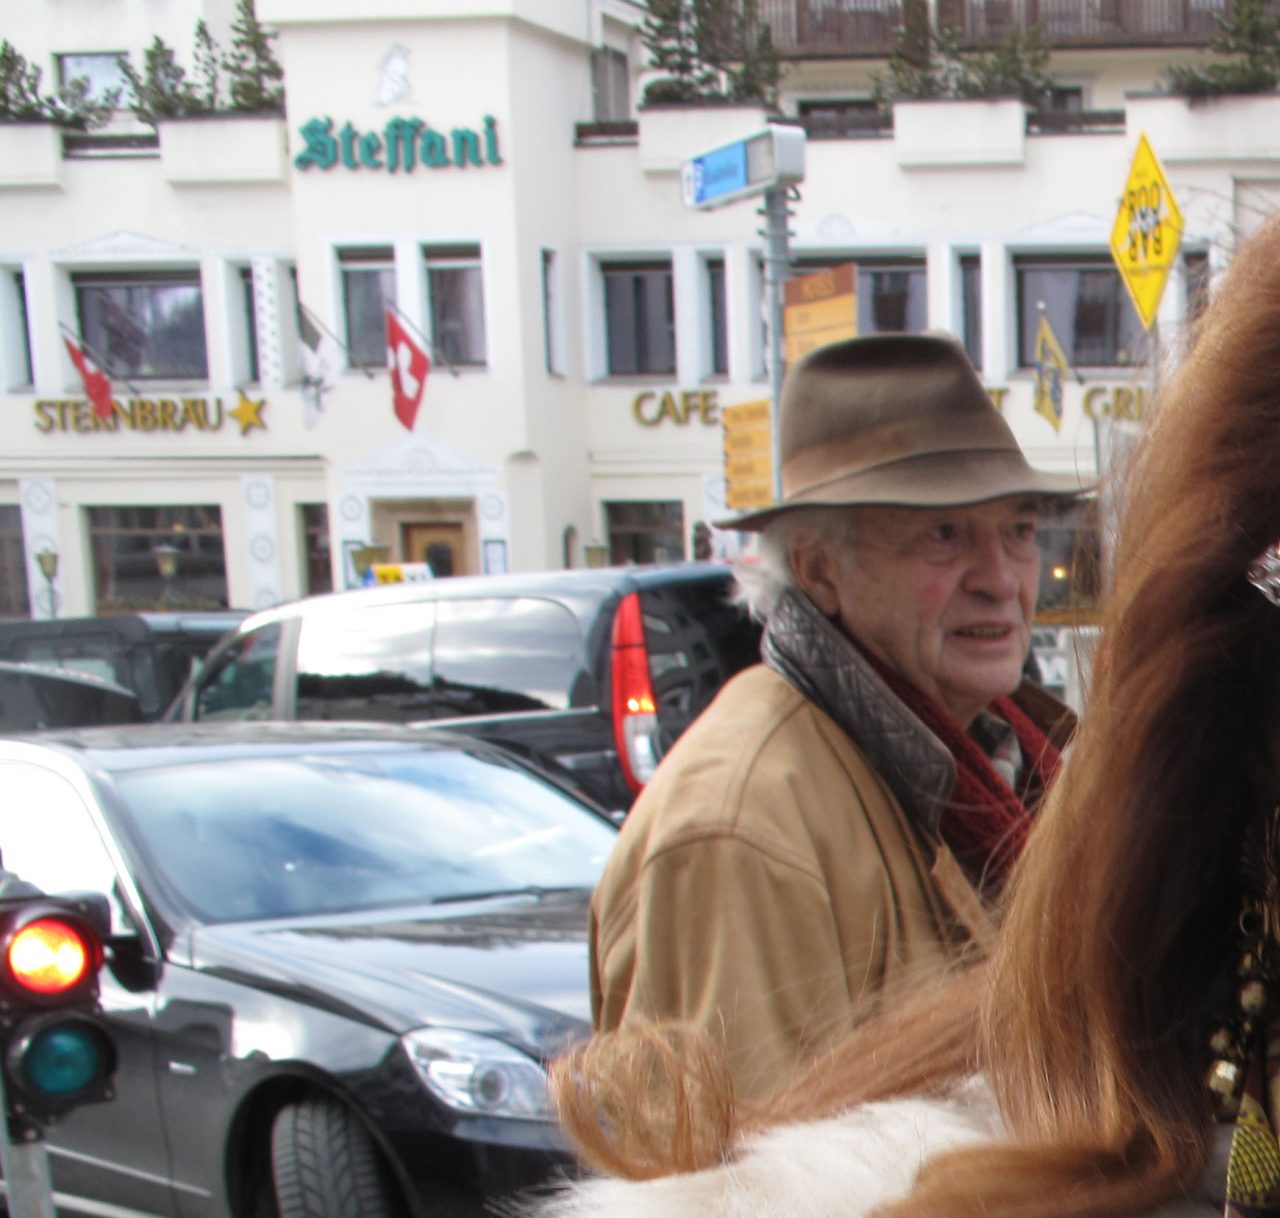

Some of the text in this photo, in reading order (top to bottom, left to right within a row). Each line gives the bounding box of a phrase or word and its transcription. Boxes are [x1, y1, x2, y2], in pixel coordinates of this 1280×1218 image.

[294, 113, 503, 174] Steffani
[631, 390, 719, 425] CAFE
[1083, 386, 1145, 421] GRI
